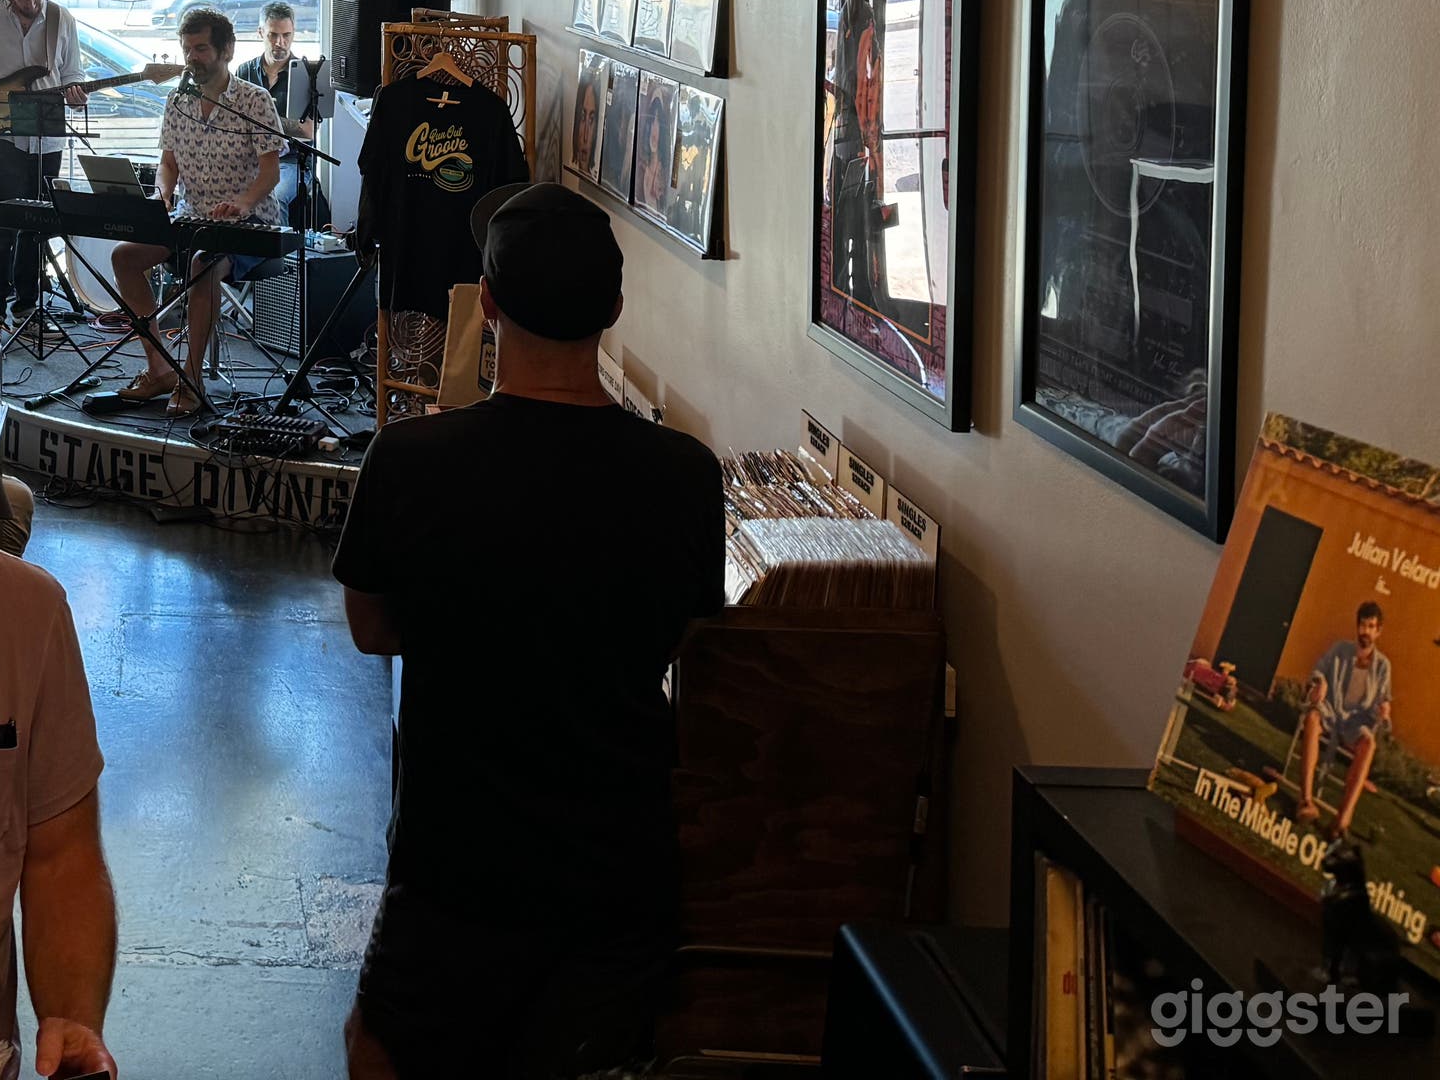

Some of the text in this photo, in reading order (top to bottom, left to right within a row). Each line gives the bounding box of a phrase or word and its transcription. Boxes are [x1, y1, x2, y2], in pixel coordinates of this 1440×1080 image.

[405, 122, 469, 170] Groove
[103, 222, 135, 233] CASIO
[39, 429, 164, 499] STAGE
[193, 461, 352, 527] DIVING
[849, 456, 874, 487] SINGLES
[897, 498, 927, 532] SINGLES
[1347, 531, 1440, 590] Julian Velard
[1195, 768, 1328, 870] In The Middle Of
